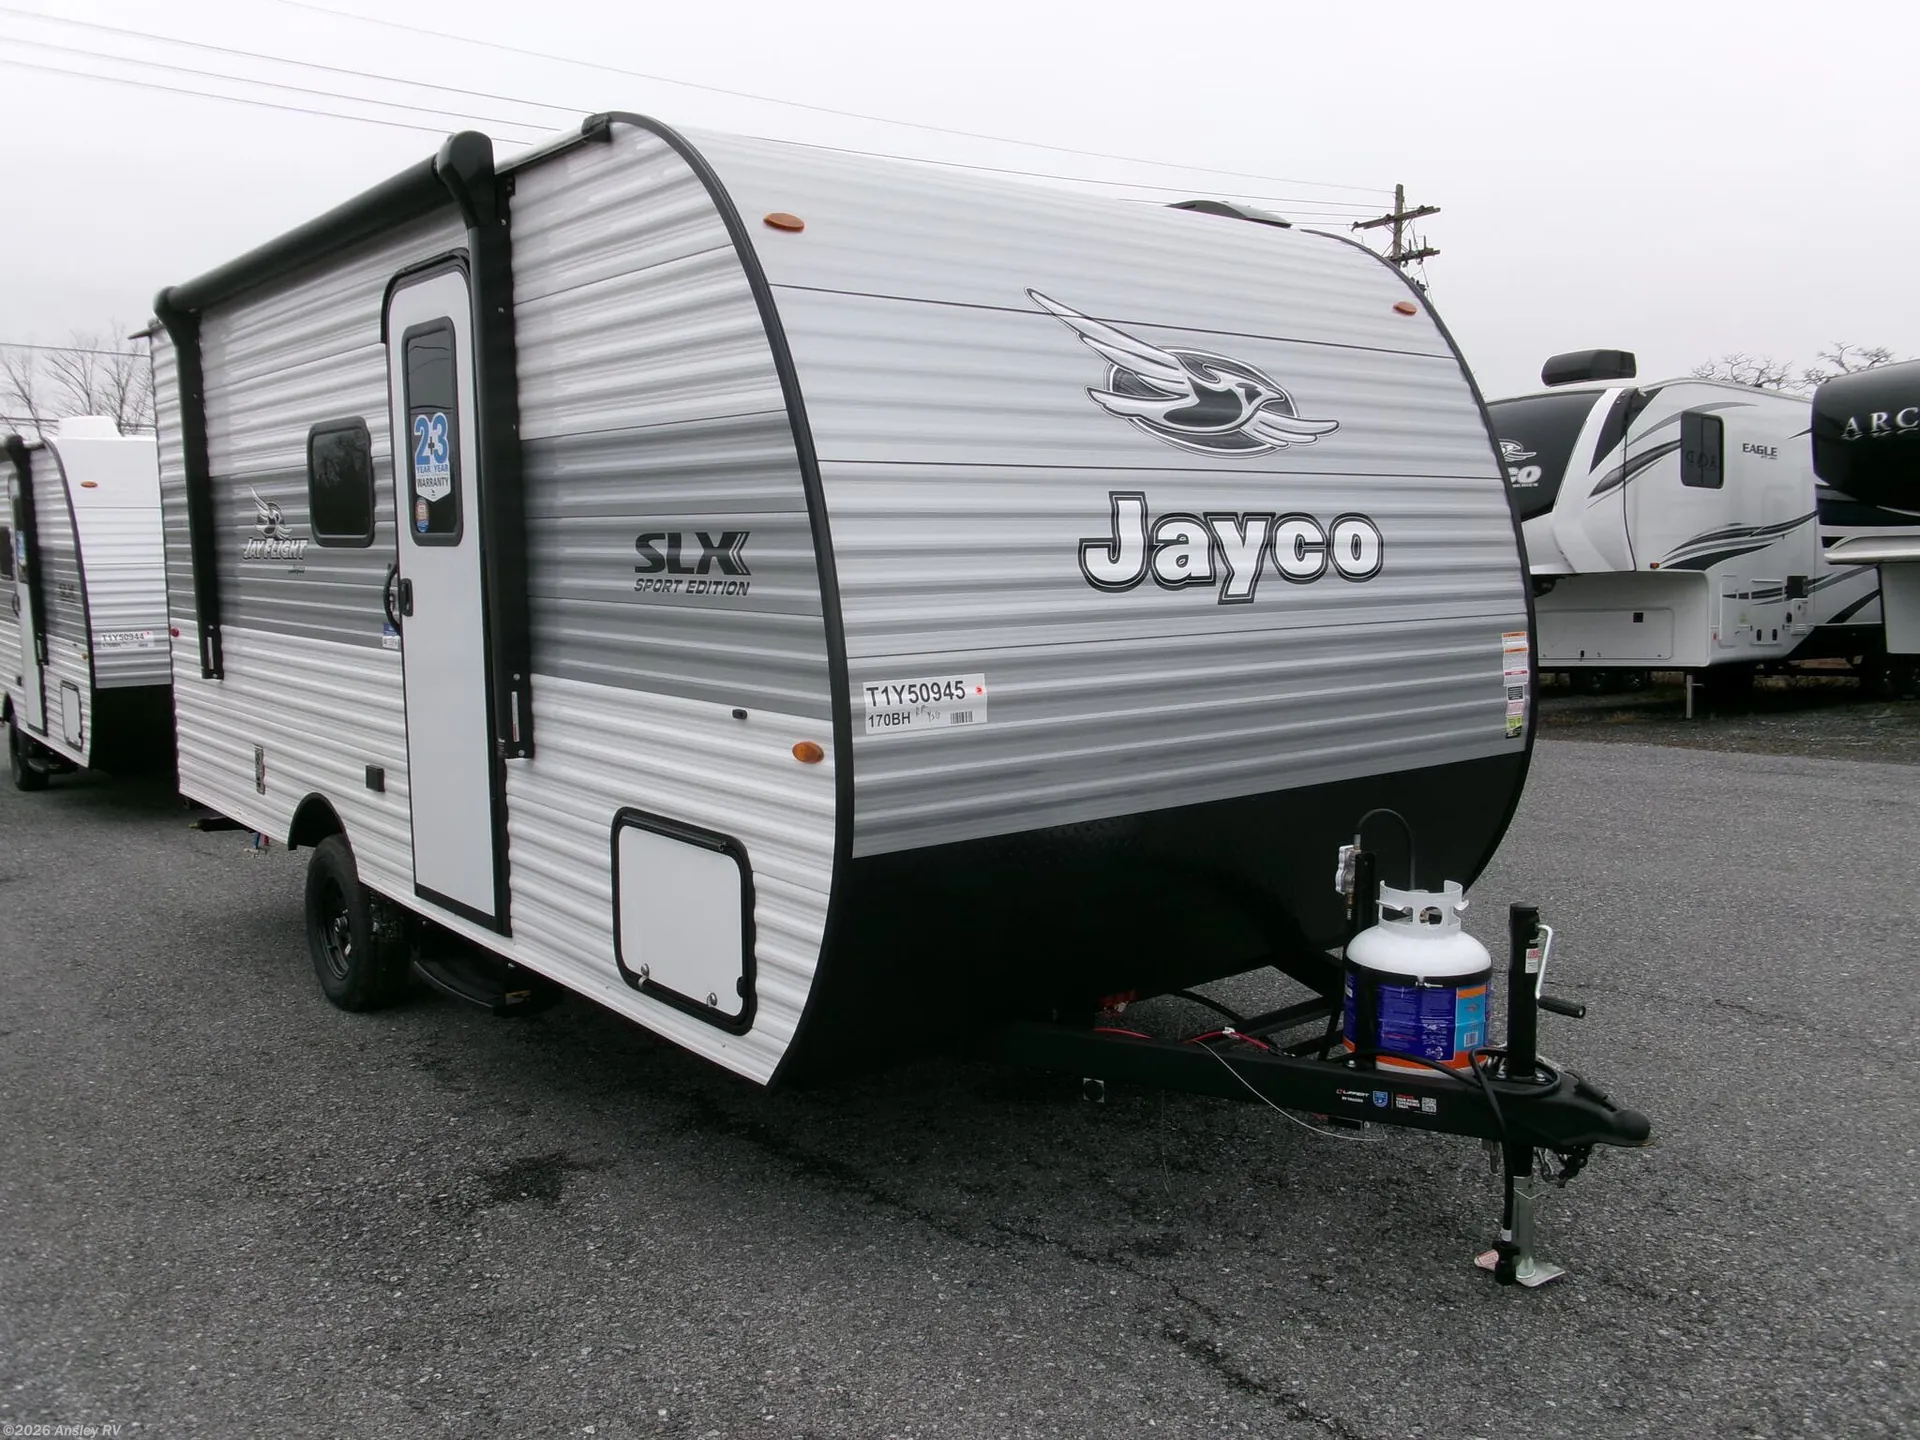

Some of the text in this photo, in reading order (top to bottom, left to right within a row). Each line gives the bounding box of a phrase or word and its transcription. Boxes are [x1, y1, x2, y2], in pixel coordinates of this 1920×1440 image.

[1742, 443, 1777, 457] EAGLE
[416, 464, 448, 474] YEAR YEAR
[417, 477, 449, 488] WARRANTY
[634, 531, 751, 576] SLX
[1078, 491, 1384, 605] Jayco
[634, 579, 750, 596] SPORT EDITION
[866, 680, 966, 707] T1Y50945
[868, 711, 911, 728] 170BH
